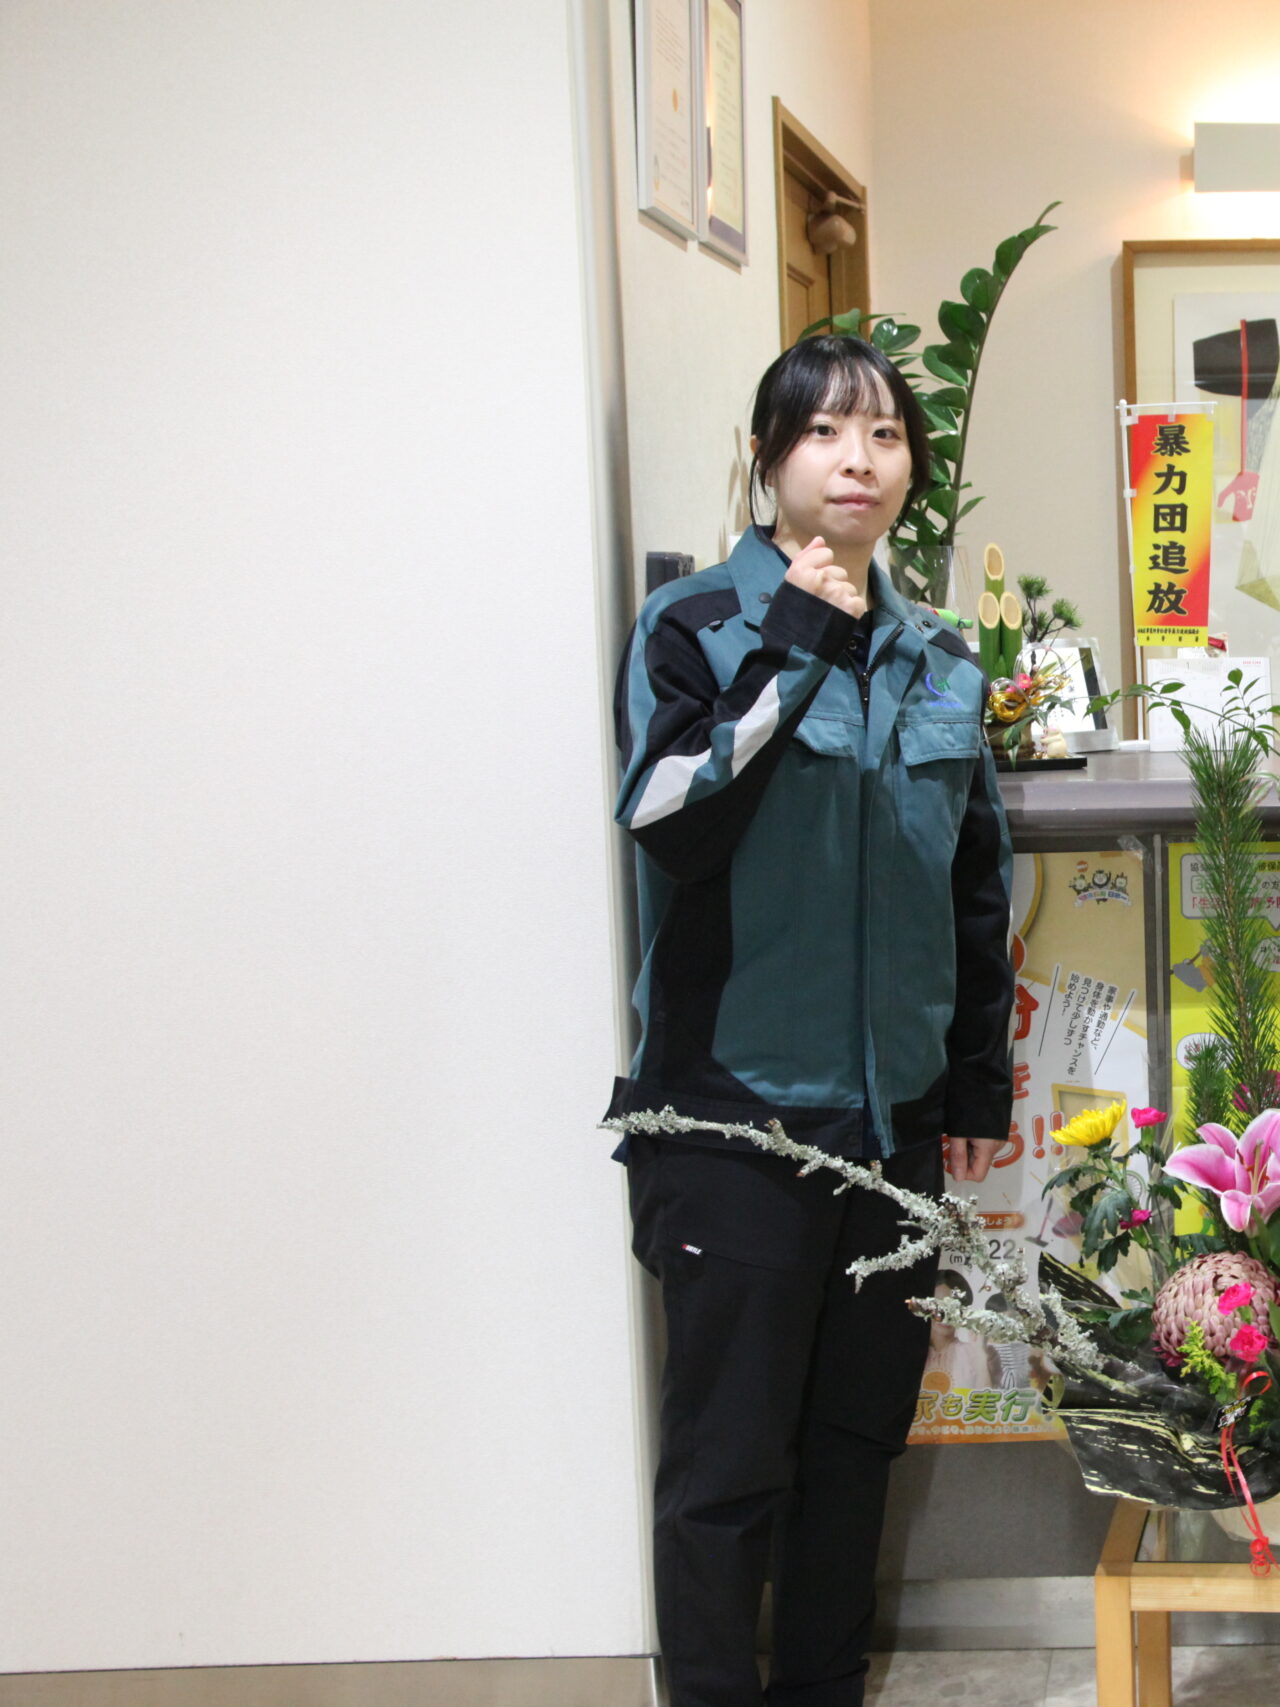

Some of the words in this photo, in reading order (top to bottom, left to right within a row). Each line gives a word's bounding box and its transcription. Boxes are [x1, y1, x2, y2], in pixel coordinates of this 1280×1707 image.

[1146, 423, 1191, 616] 暴力団追放
